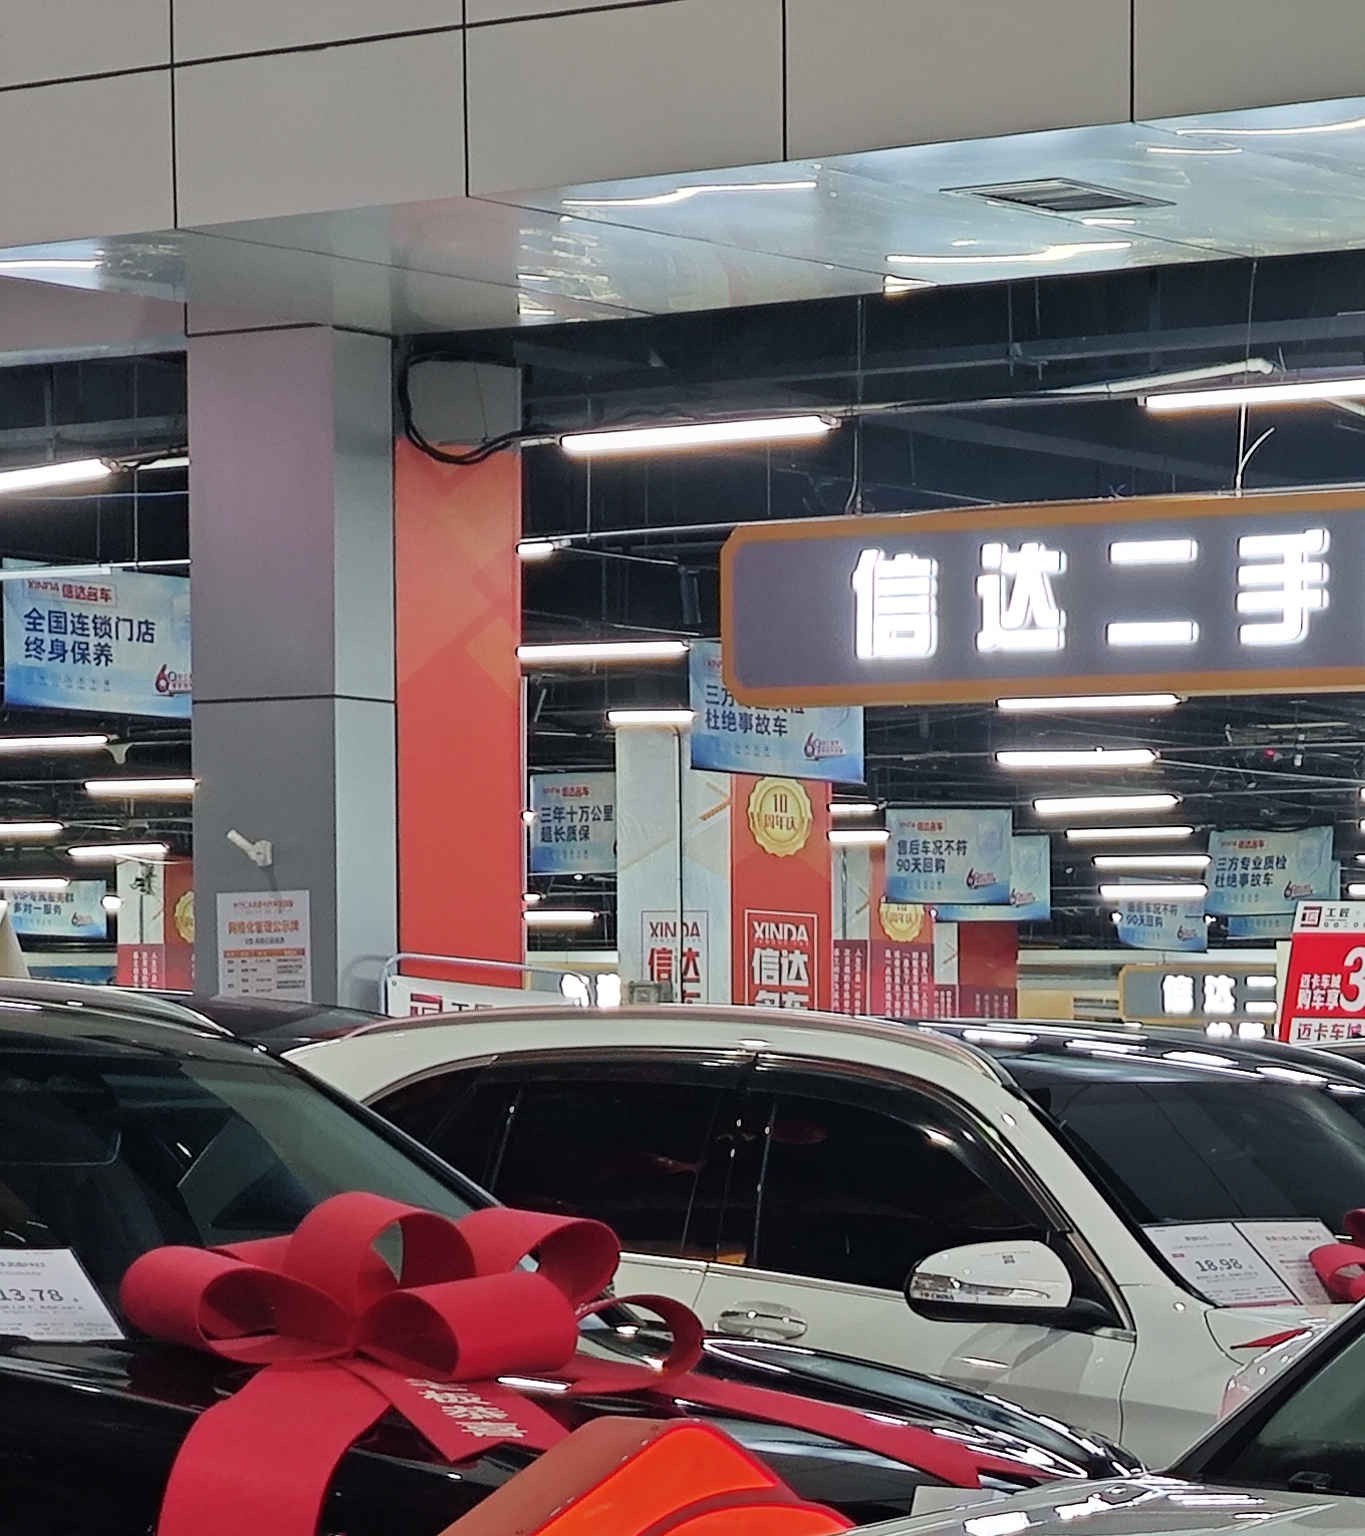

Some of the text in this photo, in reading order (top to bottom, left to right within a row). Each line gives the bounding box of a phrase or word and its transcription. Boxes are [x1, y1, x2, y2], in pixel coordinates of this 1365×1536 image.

[62, 584, 113, 602] 信达名车
[24, 607, 156, 644] 全国连锁门店
[24, 636, 114, 667] 终身保养
[705, 708, 789, 736] 杜绝事故车
[541, 805, 614, 823] 三年十万公里
[541, 825, 591, 843] 超长质保
[896, 839, 968, 855] 售后车况不符
[896, 858, 945, 874] 90天回购
[1216, 855, 1287, 872] 三方专业质检
[1214, 872, 1274, 888] 杜绝事故车
[13, 903, 62, 915] 多对一服务
[753, 921, 809, 941] XINDA
[752, 948, 809, 987] 信达
[1296, 989, 1341, 1010] 购车享
[1195, 1258, 1243, 1272] 18.98
